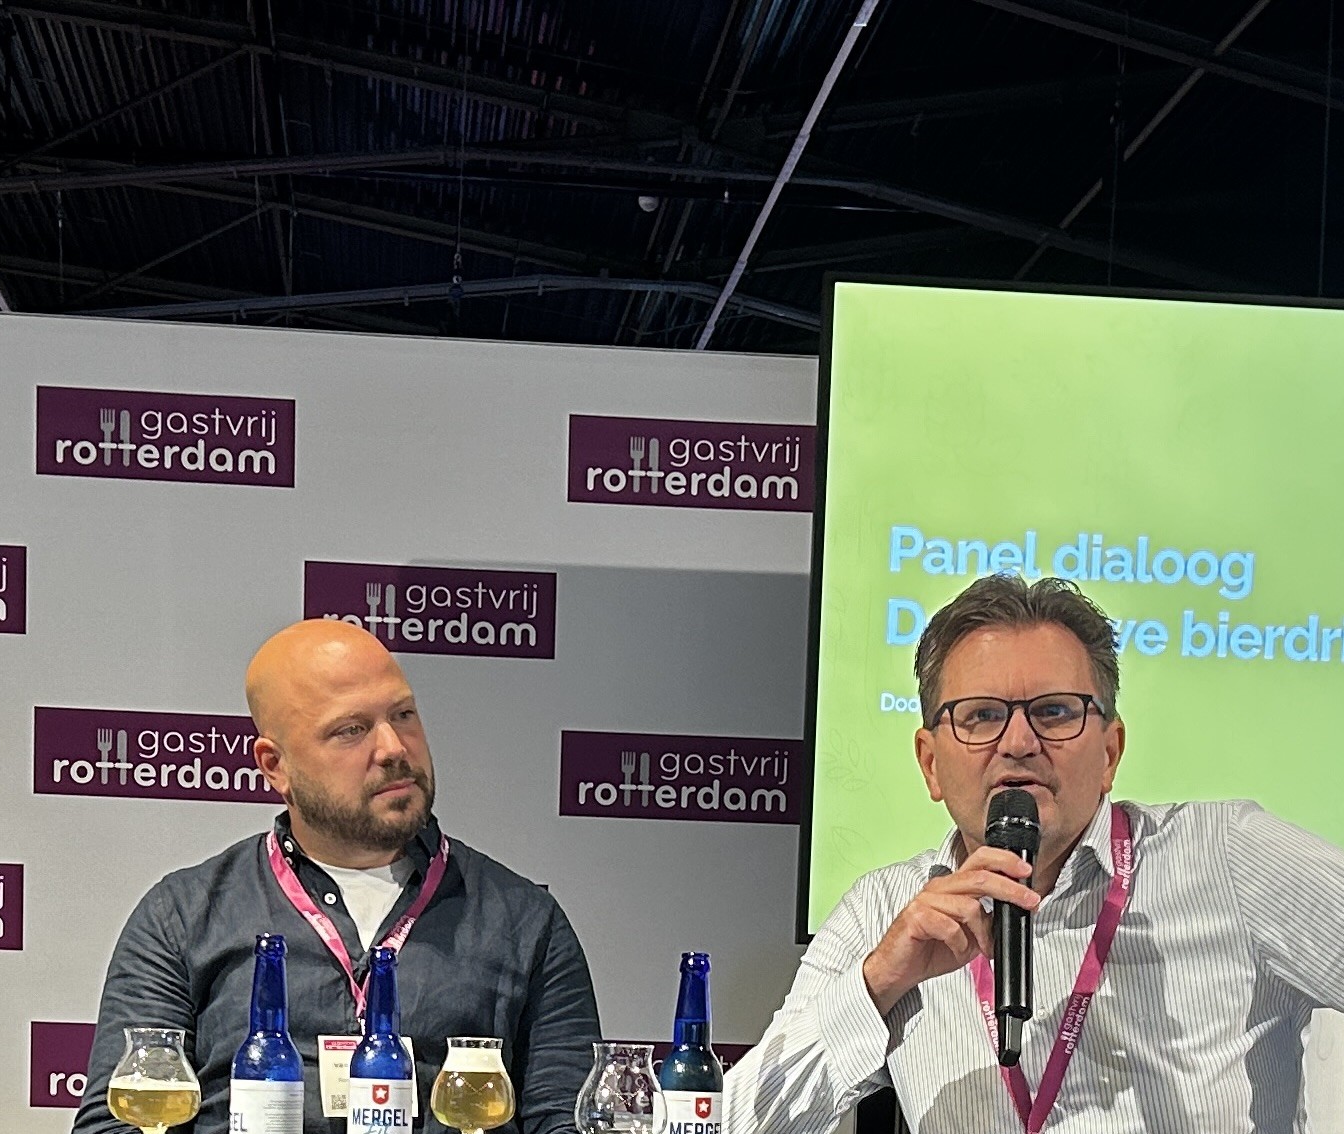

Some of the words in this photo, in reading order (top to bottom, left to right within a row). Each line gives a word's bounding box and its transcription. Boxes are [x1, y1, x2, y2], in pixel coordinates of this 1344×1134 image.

[140, 407, 276, 445] gastvrij
[55, 427, 276, 475] rotterdam
[668, 433, 800, 470] gastvrij
[585, 455, 799, 501] rotterdam
[889, 526, 1042, 580] Panel
[1052, 531, 1255, 600] dialoog
[406, 581, 538, 618] gastvrij
[323, 606, 537, 647] tterdam
[880, 692, 922, 713] Doo
[138, 726, 254, 758] gastvr
[53, 754, 273, 792] rotterdam
[659, 748, 789, 785] gastvrij
[578, 774, 787, 812] rotterdam
[1063, 996, 1091, 1055] rotterdam
[352, 1108, 408, 1127] MERGEL
